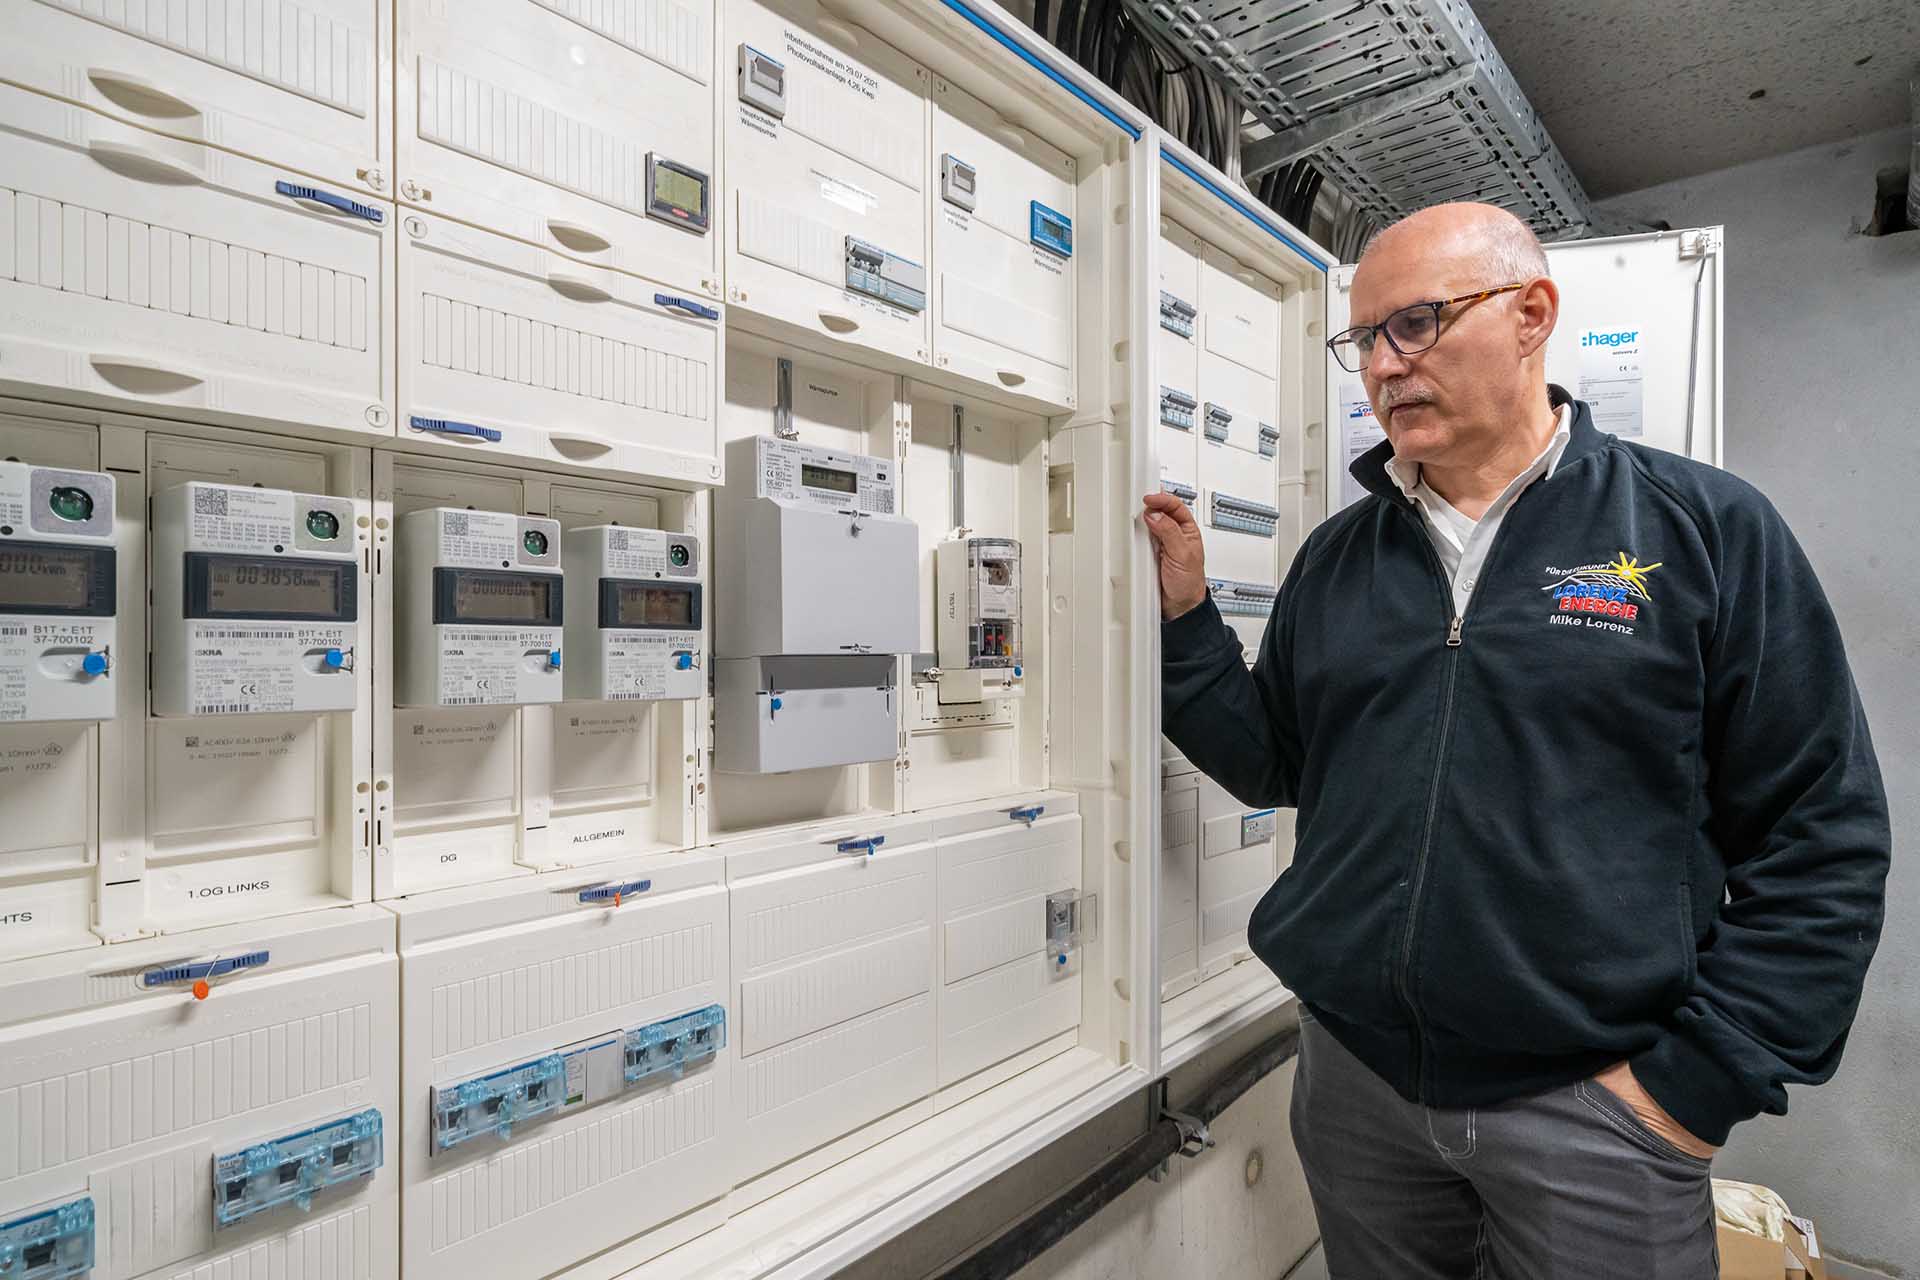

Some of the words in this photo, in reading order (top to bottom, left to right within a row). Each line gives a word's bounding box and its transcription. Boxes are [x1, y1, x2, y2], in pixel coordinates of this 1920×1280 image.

[1553, 584, 1629, 603] LORENZ
[1559, 596, 1638, 620] ENERGIE
[34, 624, 56, 634] B1T
[71, 626, 94, 635] E1T
[1550, 614, 1582, 626] Mike
[1586, 617, 1634, 635] Lorenz
[34, 635, 93, 645] 37-700102
[298, 630, 314, 638] B1T
[326, 630, 343, 638] E1T
[298, 638, 343, 646] 37-700102
[573, 829, 625, 844] ALLGEMEIN
[440, 853, 457, 863] DG
[188, 886, 223, 899] 1.OG
[228, 881, 270, 894] LINKS
